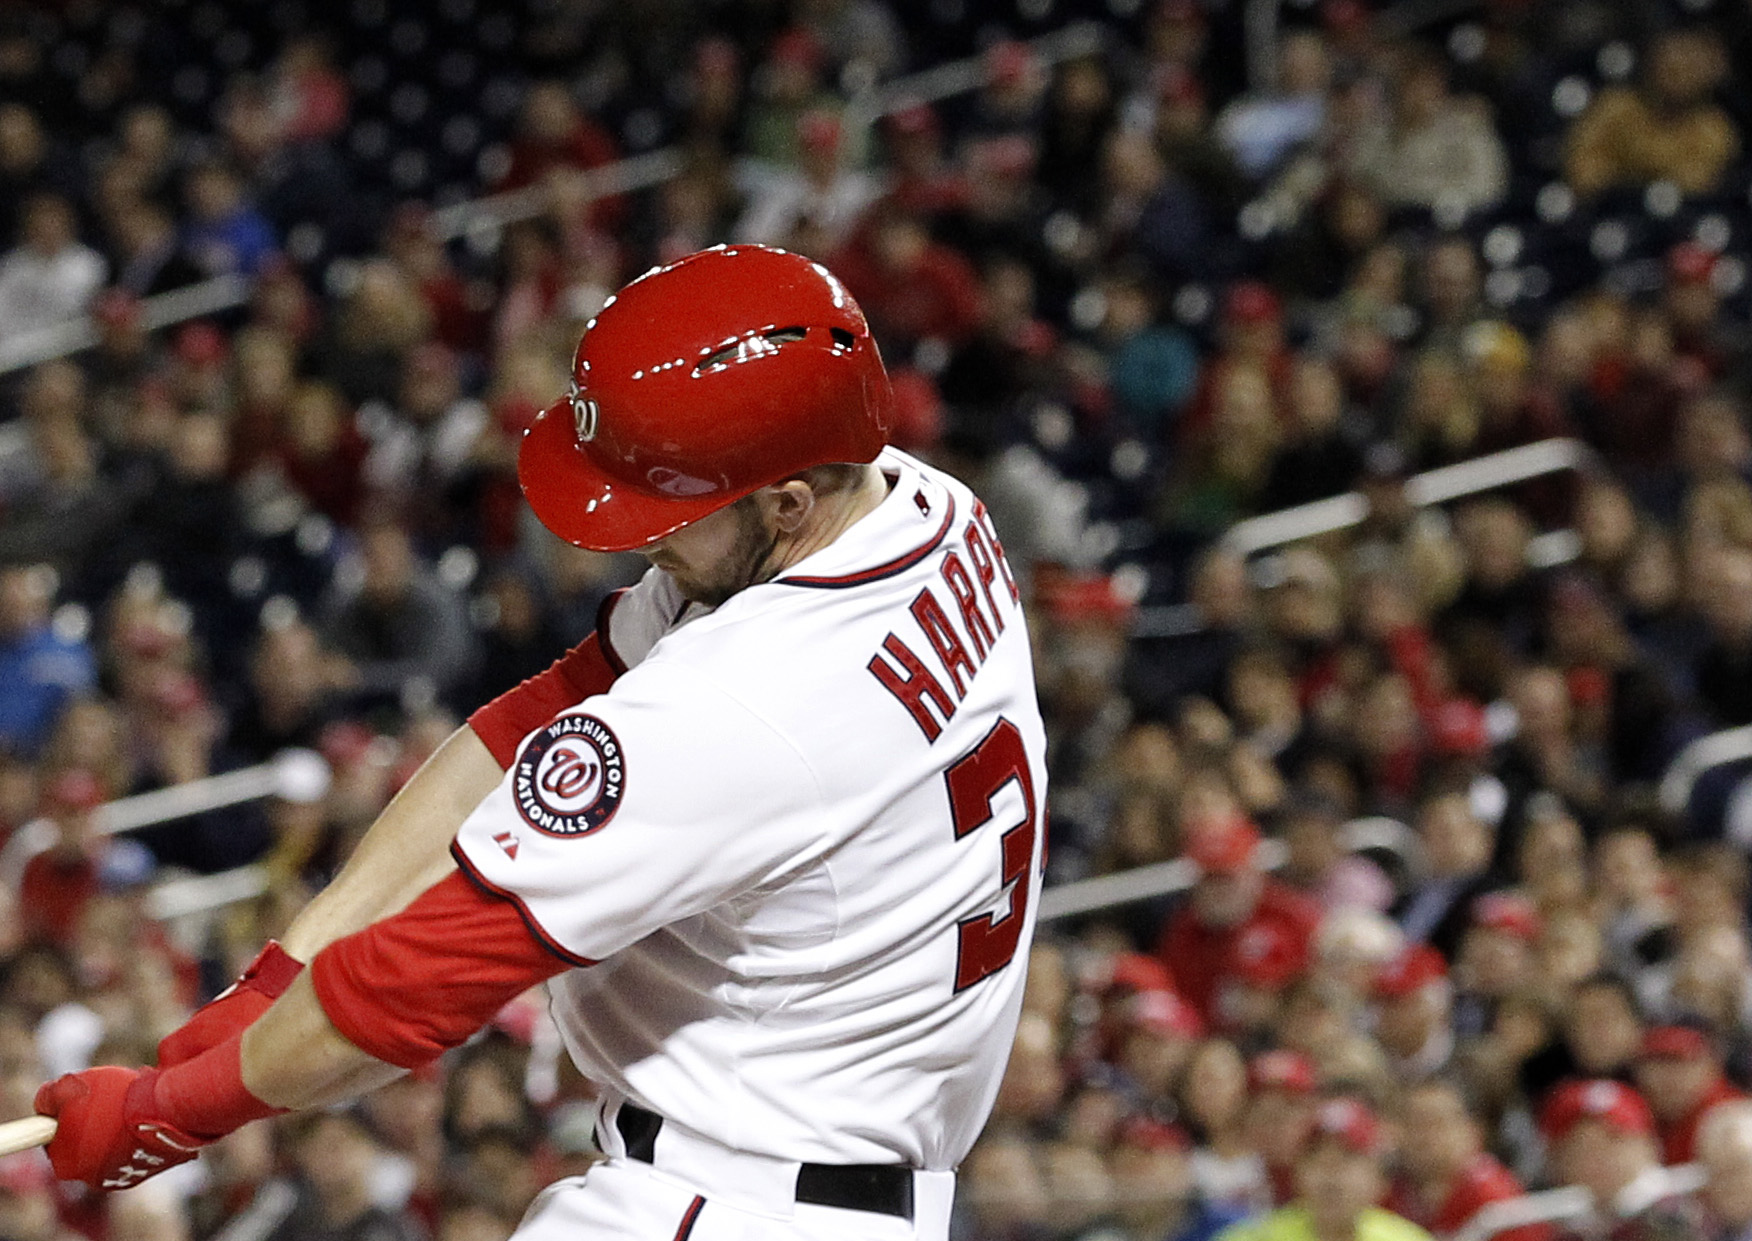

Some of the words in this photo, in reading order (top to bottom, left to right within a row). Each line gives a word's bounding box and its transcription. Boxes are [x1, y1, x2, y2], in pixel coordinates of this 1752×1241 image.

[541, 747, 598, 800] W
[547, 717, 622, 798] WASHINGTON
[517, 762, 590, 833] NATIONALS
[942, 715, 1049, 996] 3
